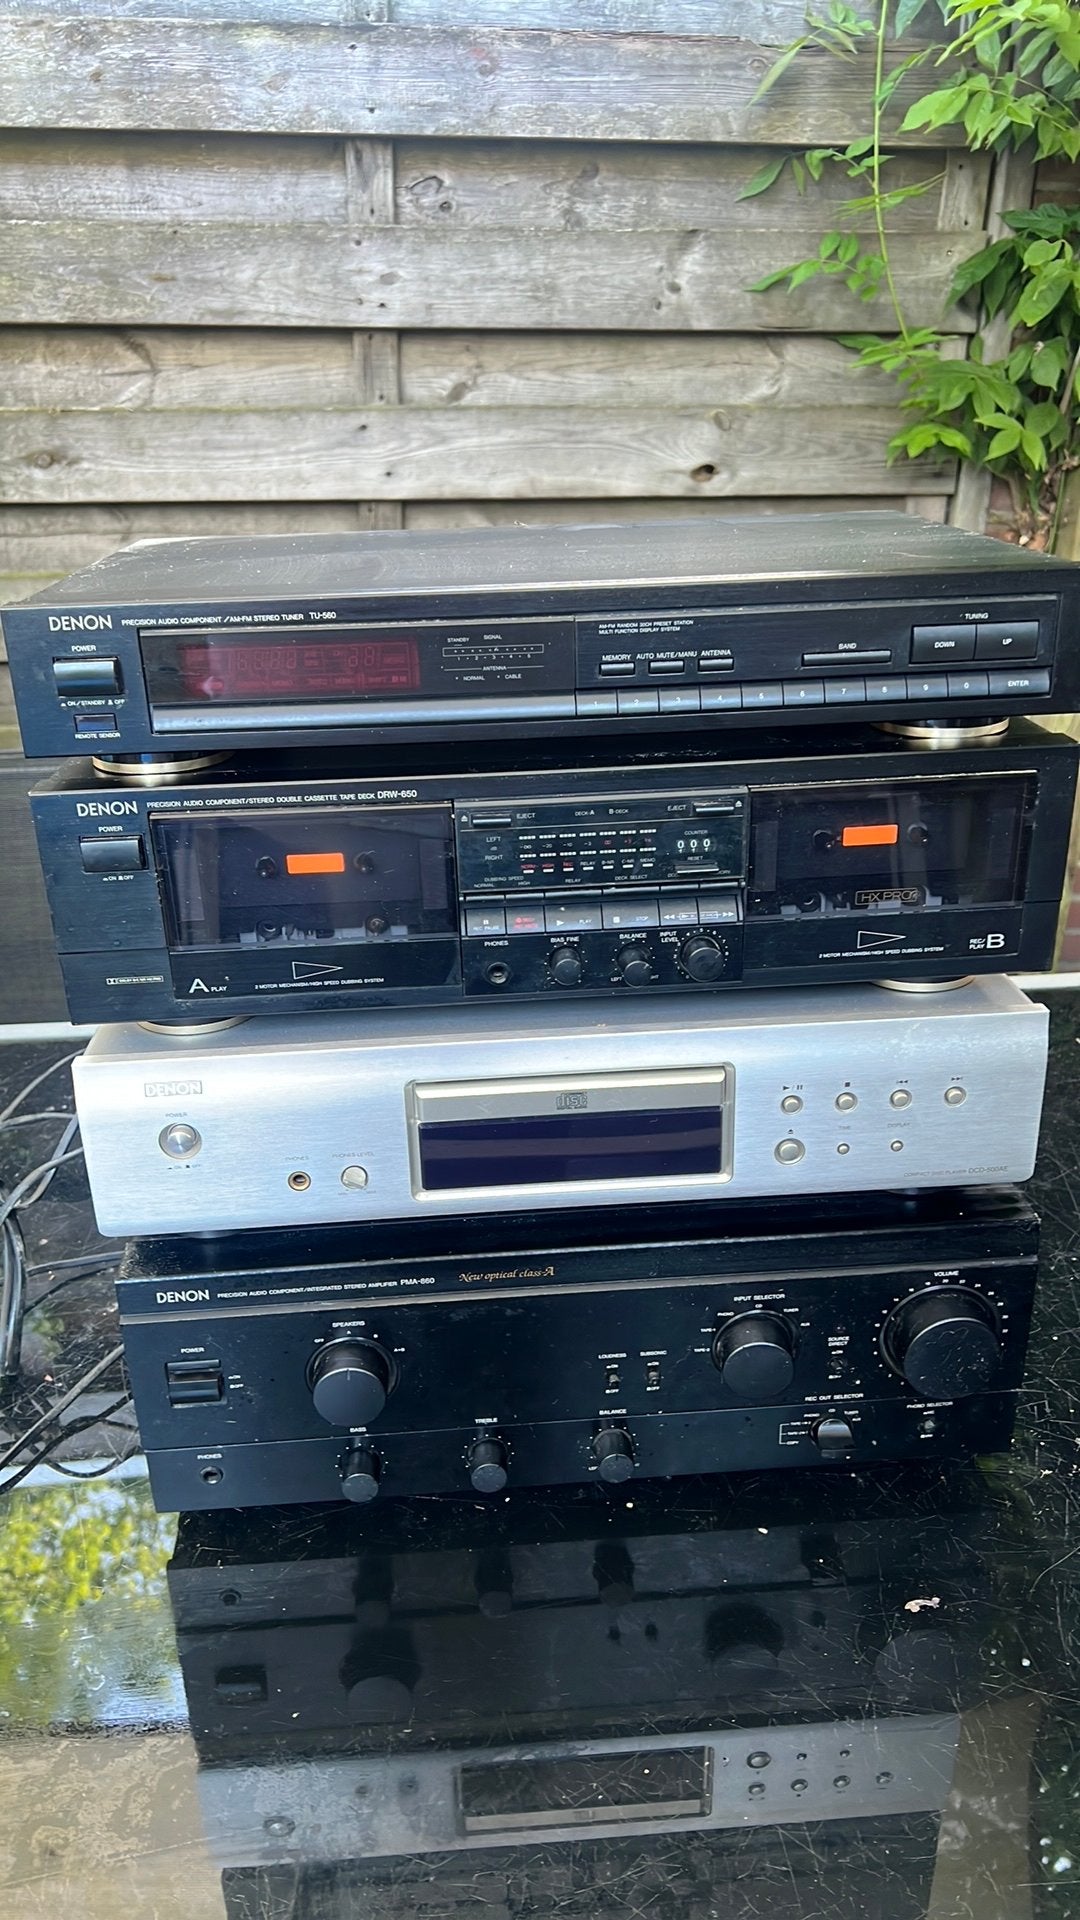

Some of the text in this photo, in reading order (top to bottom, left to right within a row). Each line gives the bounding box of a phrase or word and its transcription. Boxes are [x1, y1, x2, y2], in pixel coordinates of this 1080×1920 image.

[180, 616, 222, 624] COMPONENT
[253, 614, 280, 622] STEREO
[965, 612, 989, 620] TUNING
[48, 615, 113, 632] DENON
[934, 641, 955, 649] DOWN
[636, 652, 655, 660] AUTO
[1007, 679, 1030, 687] ENTER
[183, 799, 204, 807] AUDIO
[205, 796, 275, 806] COMPONENT/STEREO
[276, 795, 303, 803] DOUBLE
[304, 794, 338, 802] CASSETTE
[357, 792, 376, 800] DECK
[377, 789, 418, 799] DRW-650
[76, 800, 139, 818] DENON
[667, 804, 687, 812] EJECT
[98, 825, 124, 833] POWER
[677, 838, 711, 848] 0 0 0
[860, 892, 880, 902] HX
[619, 932, 648, 940] BALANCE
[986, 933, 1005, 949] B
[188, 978, 210, 994] A
[145, 1082, 202, 1096] DENON
[459, 1266, 556, 1283] New optical class-A
[343, 1283, 367, 1291] STEREO
[368, 1281, 398, 1289] AMPLIFIER
[156, 1290, 210, 1304] DENON
[332, 1320, 366, 1328] SPEAKERS
[753, 1293, 786, 1301] SELECTOR
[833, 1393, 864, 1401] SELECTOR
[474, 1417, 499, 1425] TREBLE
